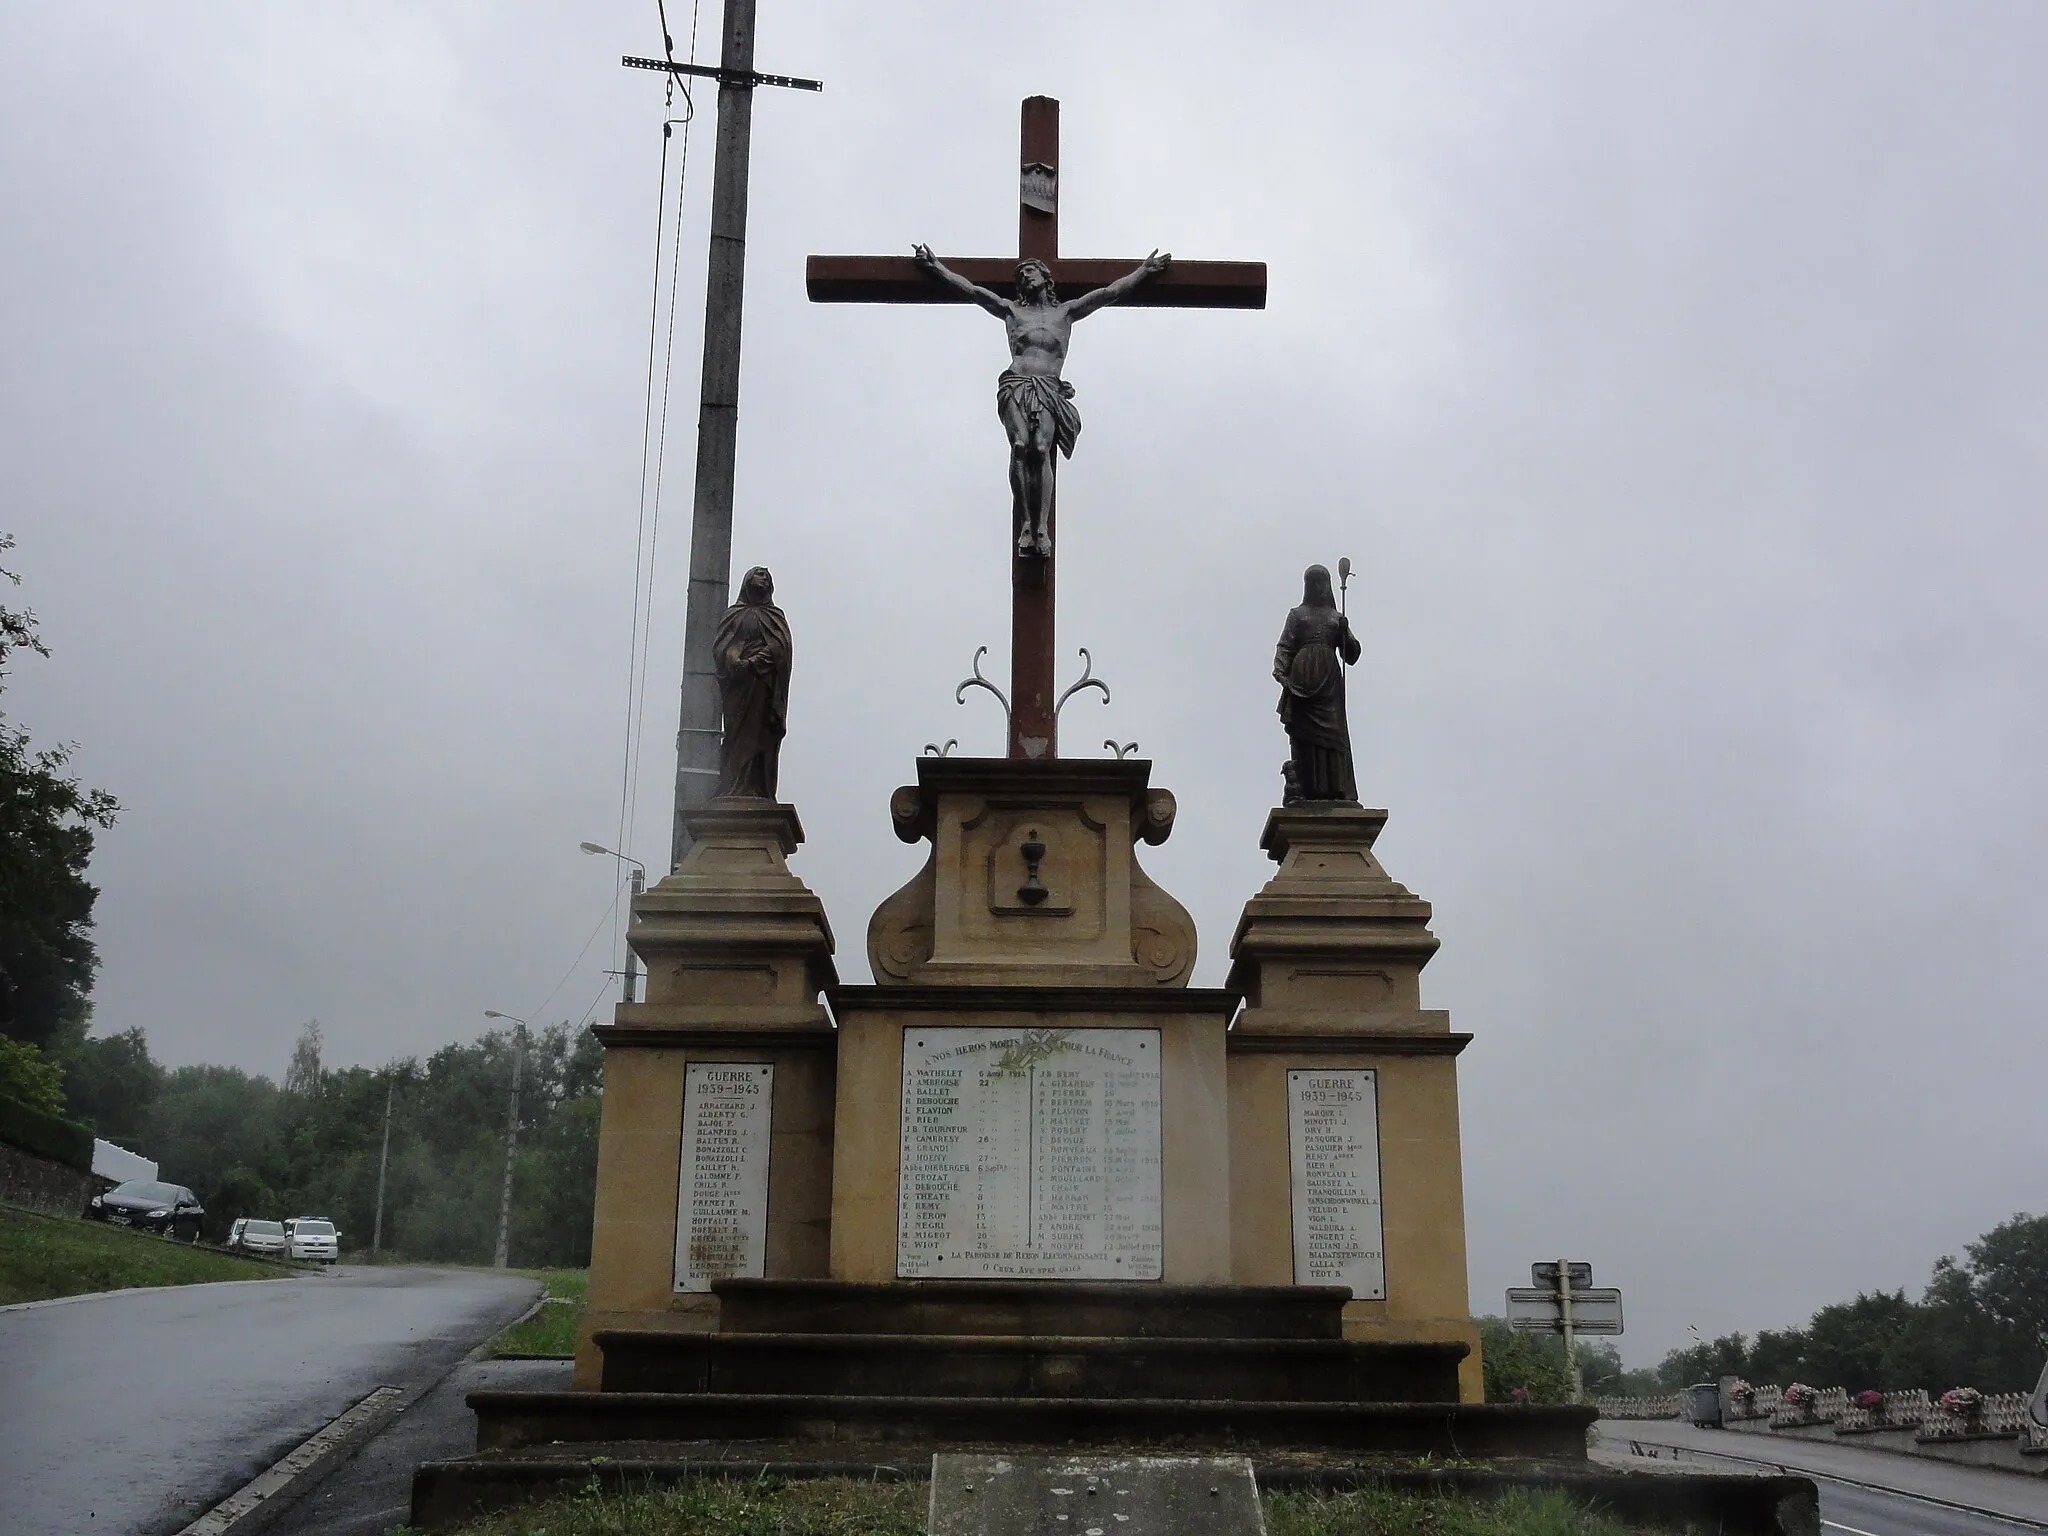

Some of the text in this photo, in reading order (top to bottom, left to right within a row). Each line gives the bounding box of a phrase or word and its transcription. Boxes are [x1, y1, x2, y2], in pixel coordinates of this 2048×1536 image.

[955, 1042, 987, 1055] HEROS
[989, 1038, 1020, 1049] MORTS
[707, 1071, 753, 1082] GUERRE
[916, 1069, 963, 1077] WATHELET
[1308, 1078, 1355, 1089] GUERRE
[916, 1106, 953, 1114] FLAVION
[923, 1125, 968, 1133] TOURNEUR
[916, 1135, 960, 1143] CAMBRESY
[914, 1231, 952, 1239] MIGEOT
[914, 1241, 940, 1249] WIOT
[965, 1251, 1000, 1260] PAROISSE
[1042, 1251, 1108, 1261] RECONNAISSANTE
